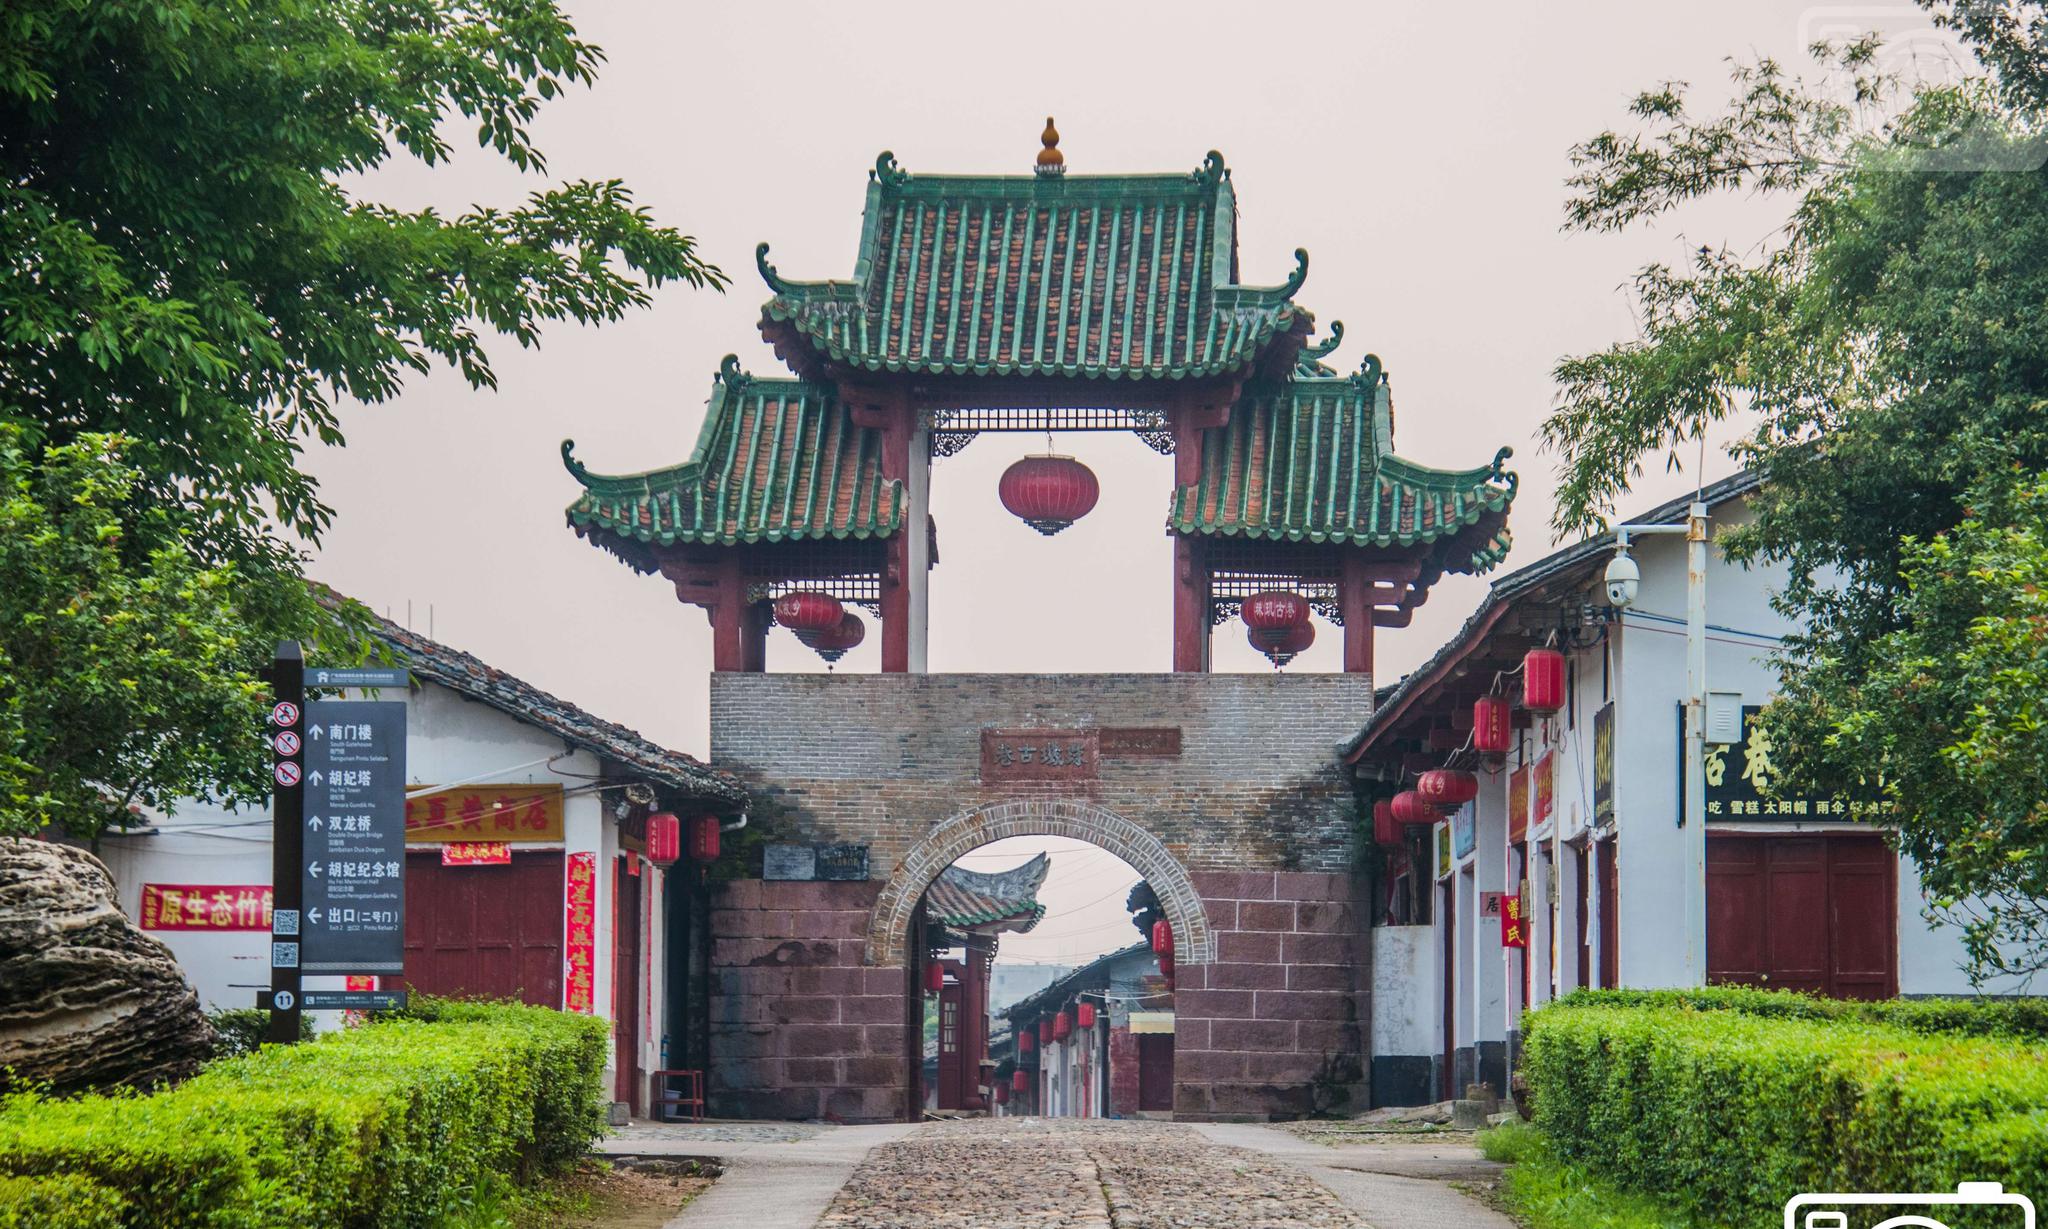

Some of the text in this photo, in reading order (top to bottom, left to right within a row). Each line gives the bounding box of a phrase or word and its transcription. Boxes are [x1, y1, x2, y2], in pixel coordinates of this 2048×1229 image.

[329, 724, 372, 740] 南门楼
[329, 770, 371, 786] 胡妃塔
[1704, 801, 1722, 814] 吃
[1730, 801, 1759, 815] 雪糕
[1764, 801, 1808, 815] 太阳帽
[1816, 801, 1845, 815] 雨伞
[329, 816, 371, 831] 双龙桥
[328, 862, 400, 877] 胡妃纪念馆
[278, 995, 291, 1005] 11
